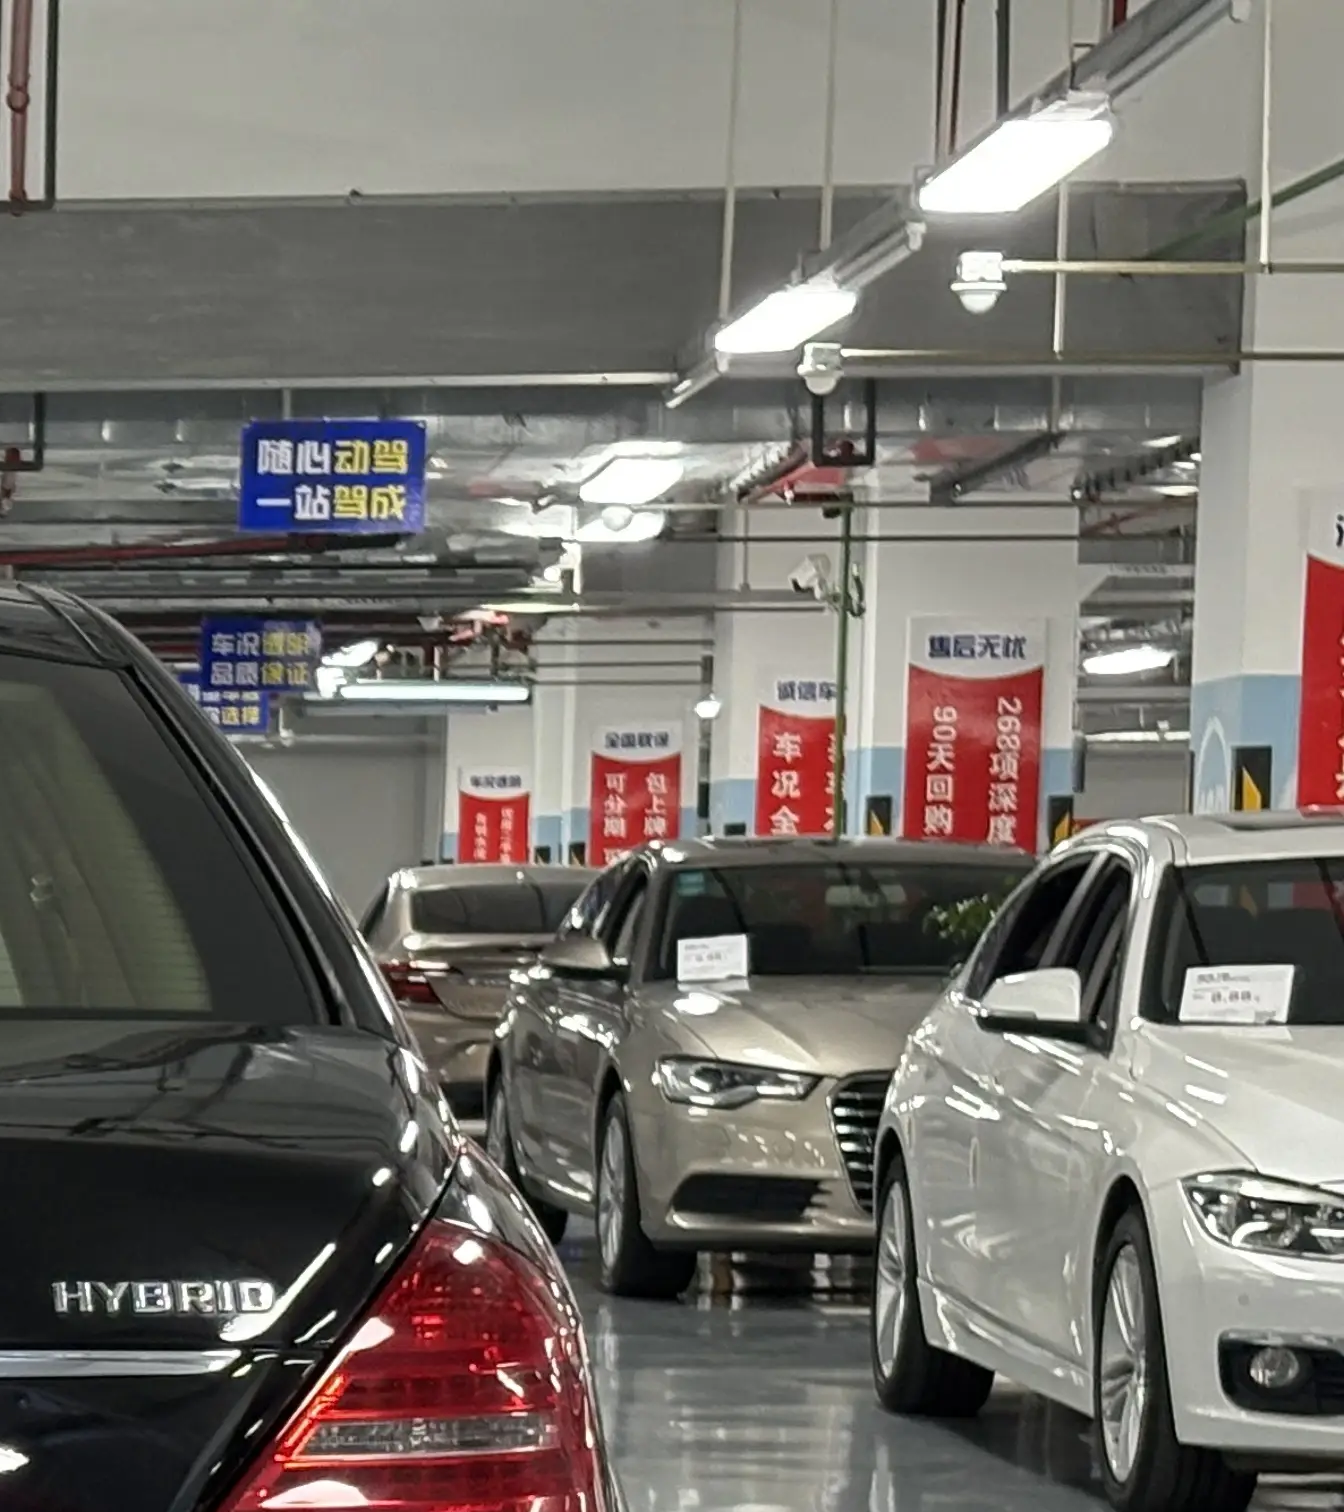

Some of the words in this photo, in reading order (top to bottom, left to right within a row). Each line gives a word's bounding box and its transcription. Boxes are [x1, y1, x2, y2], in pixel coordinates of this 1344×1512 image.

[257, 439, 410, 475] 随心动驾
[256, 484, 406, 521] 一站驾成
[928, 633, 1027, 660] 售后无忧
[51, 1280, 277, 1314] HYBRID
